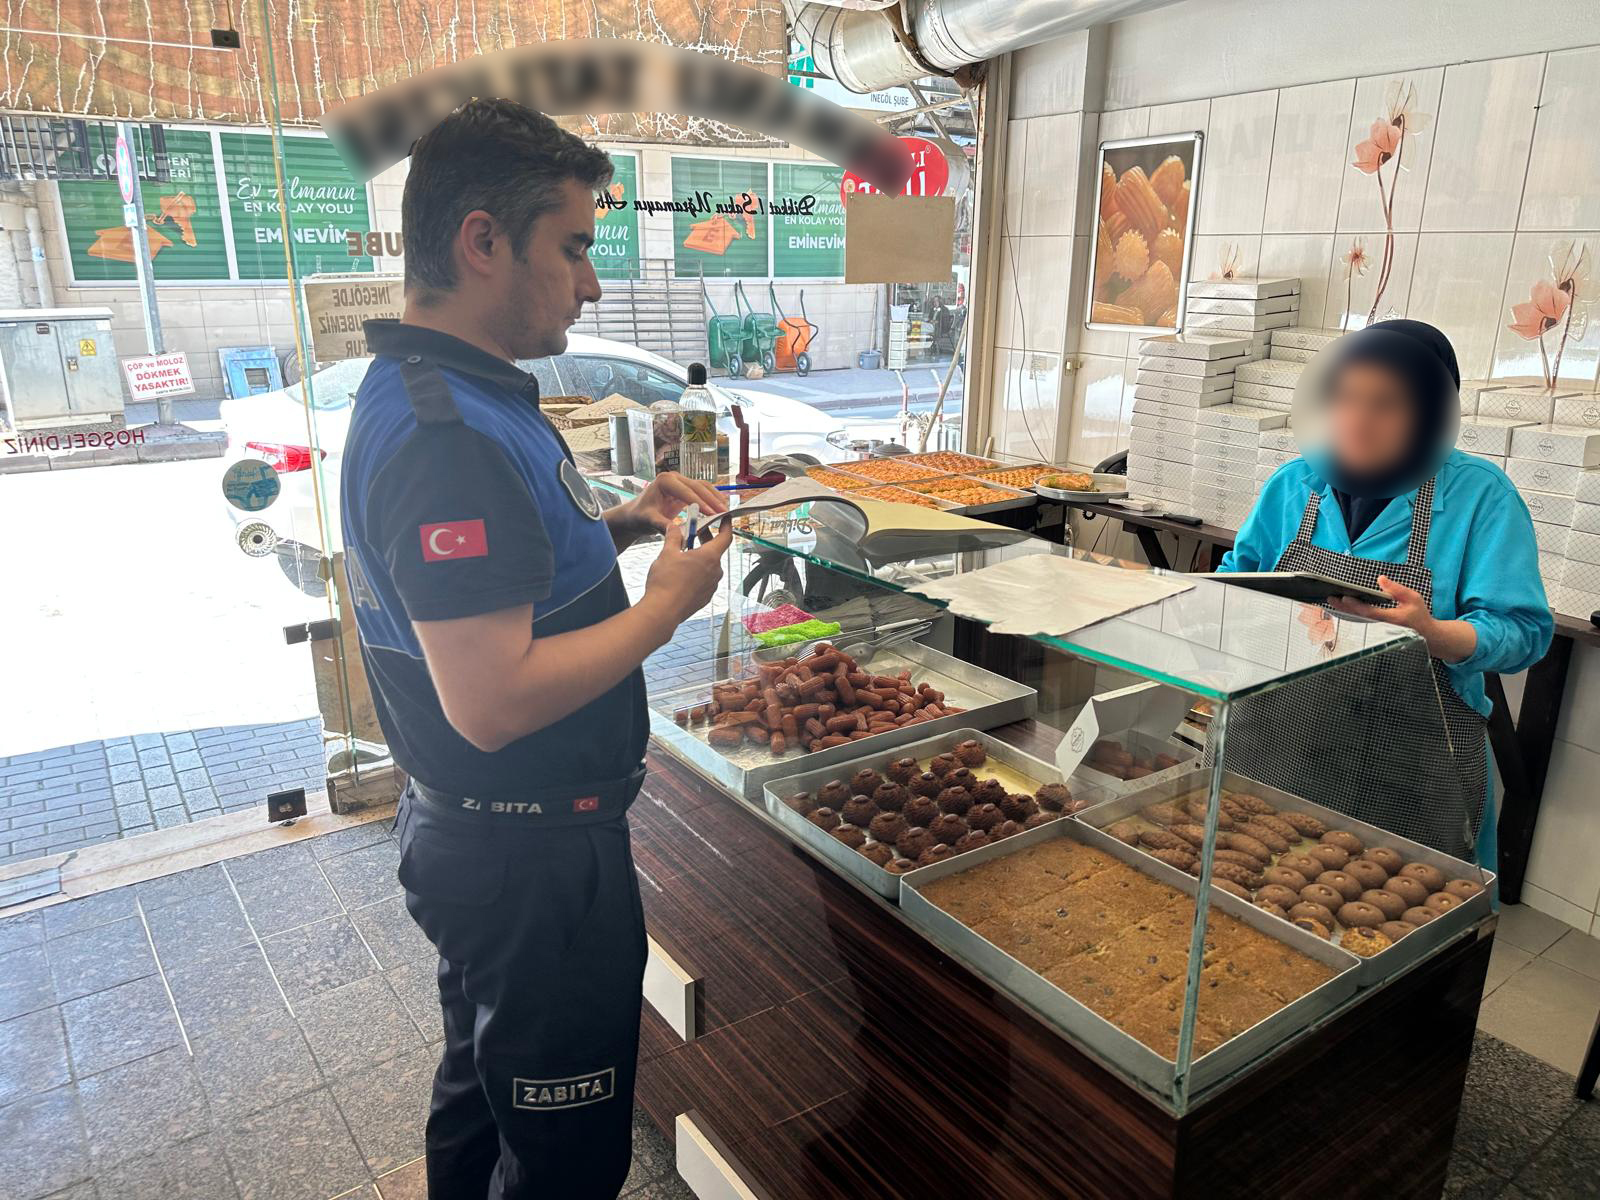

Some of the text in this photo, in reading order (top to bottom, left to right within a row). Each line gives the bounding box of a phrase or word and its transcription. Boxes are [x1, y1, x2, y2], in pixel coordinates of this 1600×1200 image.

[236, 177, 262, 201] Ev
[244, 202, 263, 213] EN
[318, 203, 353, 214] YOLU
[784, 216, 797, 225] EN
[798, 216, 826, 225] KOLAY
[255, 223, 350, 244] EMNEVİM
[788, 232, 846, 249] EMİNEVİM
[156, 356, 184, 367] MOLOZ
[134, 377, 189, 393] YASAKTIR!
[523, 1079, 604, 1104] ZABITA
